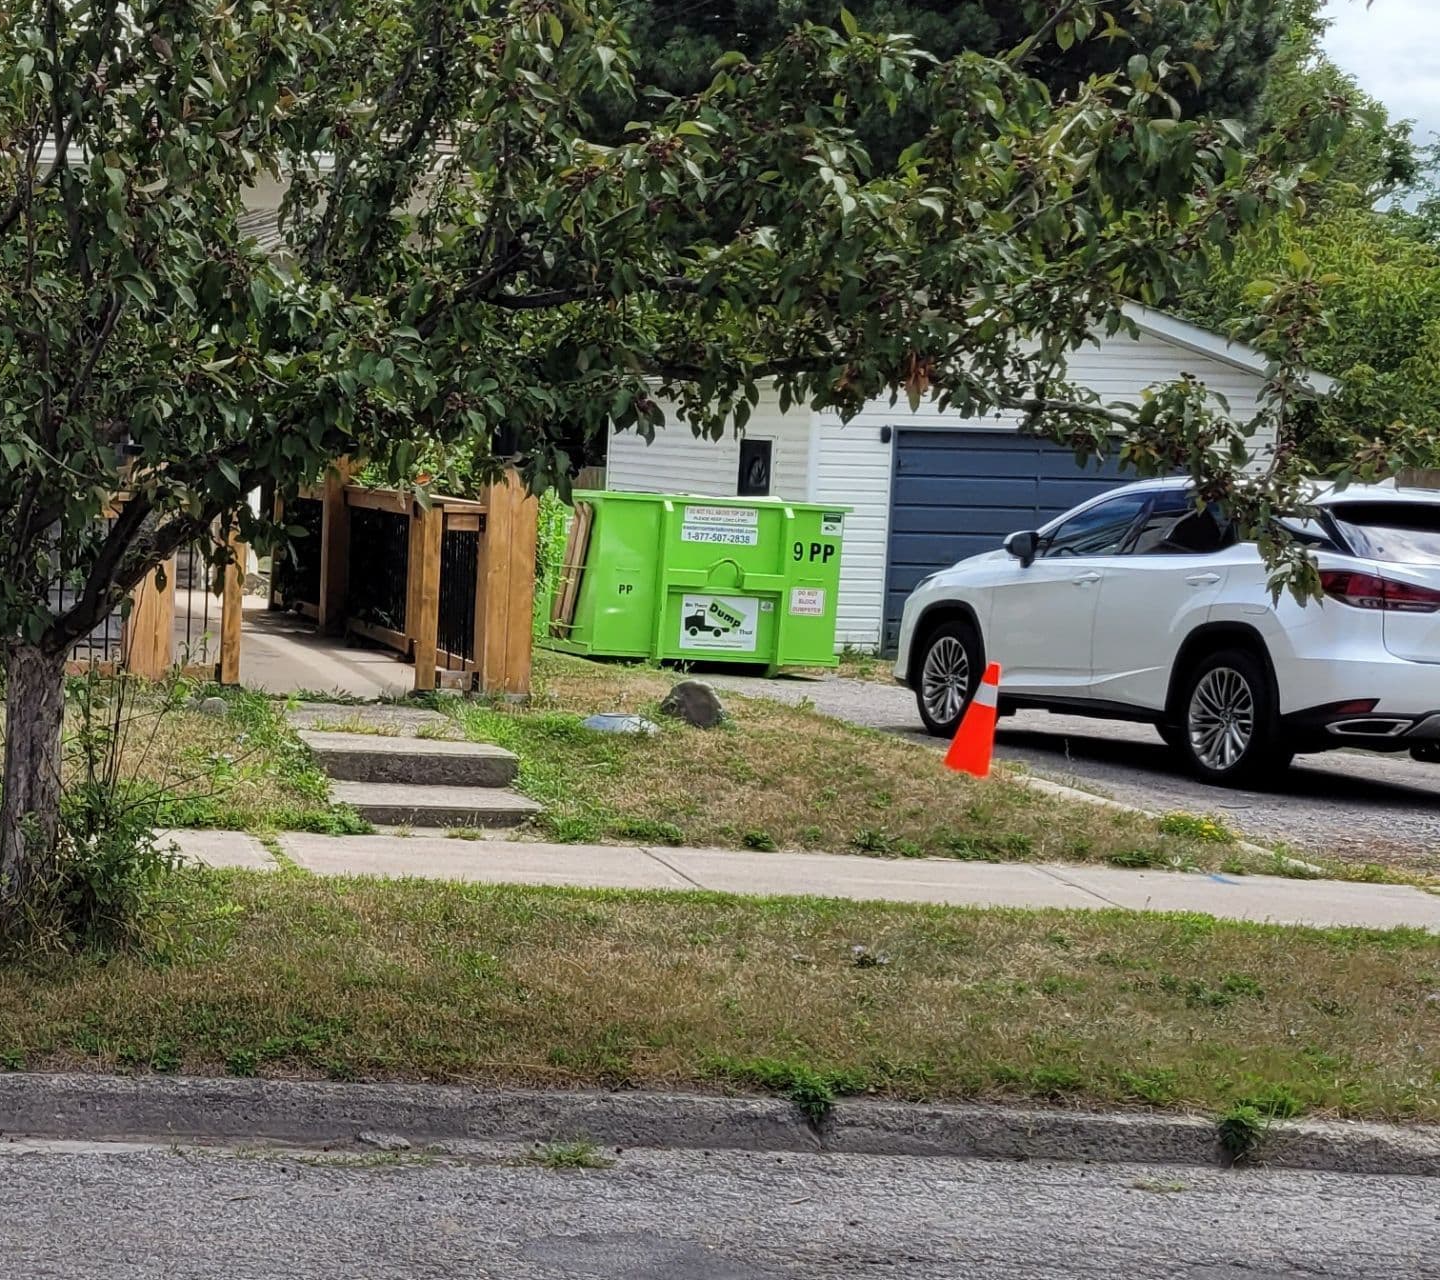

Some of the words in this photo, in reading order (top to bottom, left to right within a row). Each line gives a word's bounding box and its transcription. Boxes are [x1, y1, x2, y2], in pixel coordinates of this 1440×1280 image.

[793, 542, 803, 561] 9
[809, 542, 835, 563] PP
[619, 584, 633, 594] PP
[709, 603, 741, 628] Dump
